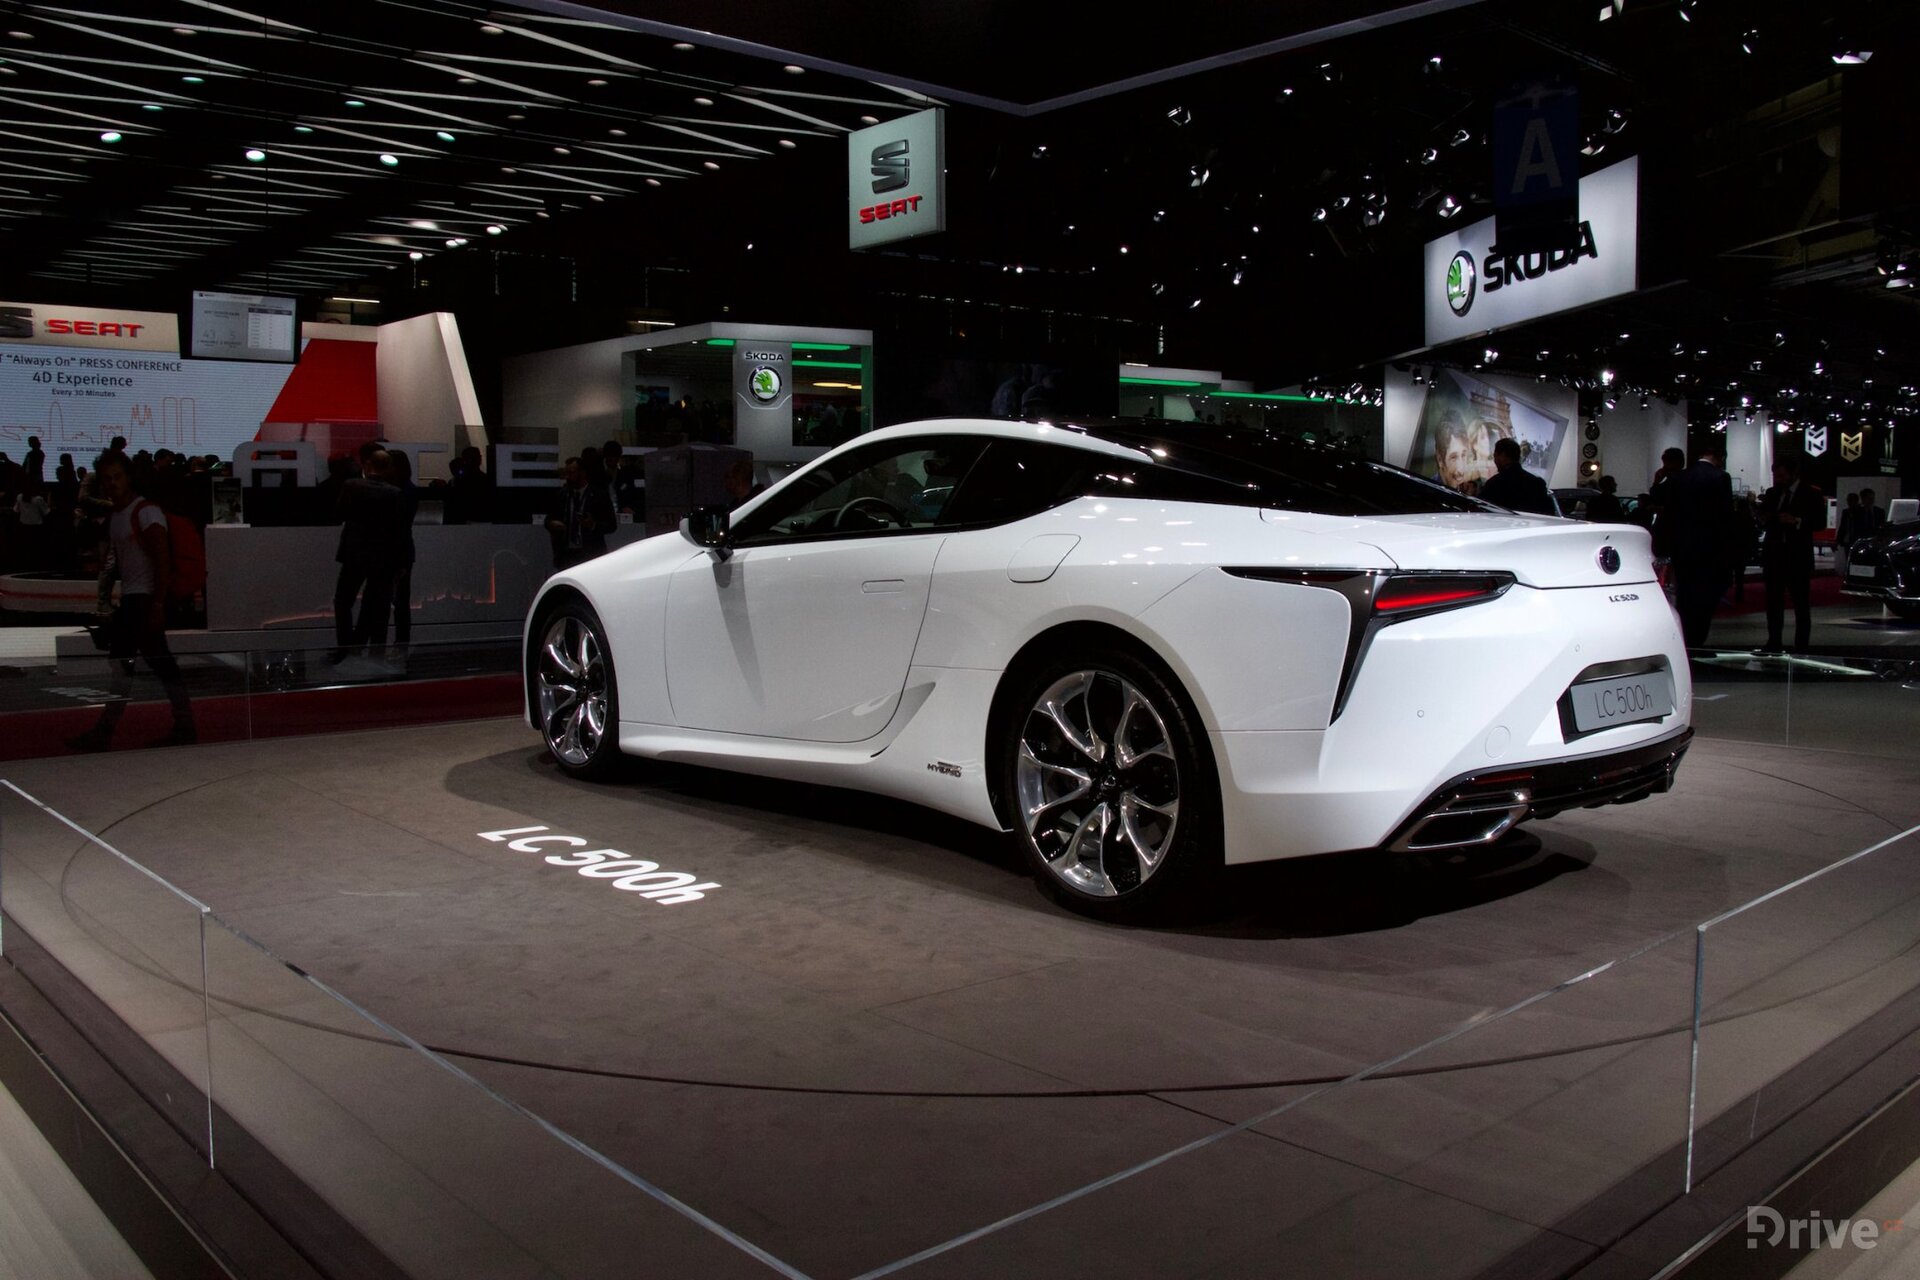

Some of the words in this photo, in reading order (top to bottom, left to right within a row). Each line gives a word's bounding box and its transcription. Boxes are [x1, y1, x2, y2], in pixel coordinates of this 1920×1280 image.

[1510, 117, 1563, 194] A
[858, 194, 923, 225] SEAT
[46, 318, 145, 339] SEAT
[79, 357, 114, 369] PRESS
[116, 359, 183, 372] CONFERENCE
[32, 371, 52, 384] 4D
[57, 371, 134, 387] Experience
[51, 388, 73, 398] Every
[75, 388, 85, 397] 30
[86, 389, 116, 398] Minutes
[1594, 689, 1617, 719] LC
[1616, 683, 1653, 714] 500h
[476, 825, 588, 854] LC
[544, 848, 723, 906] 500h
